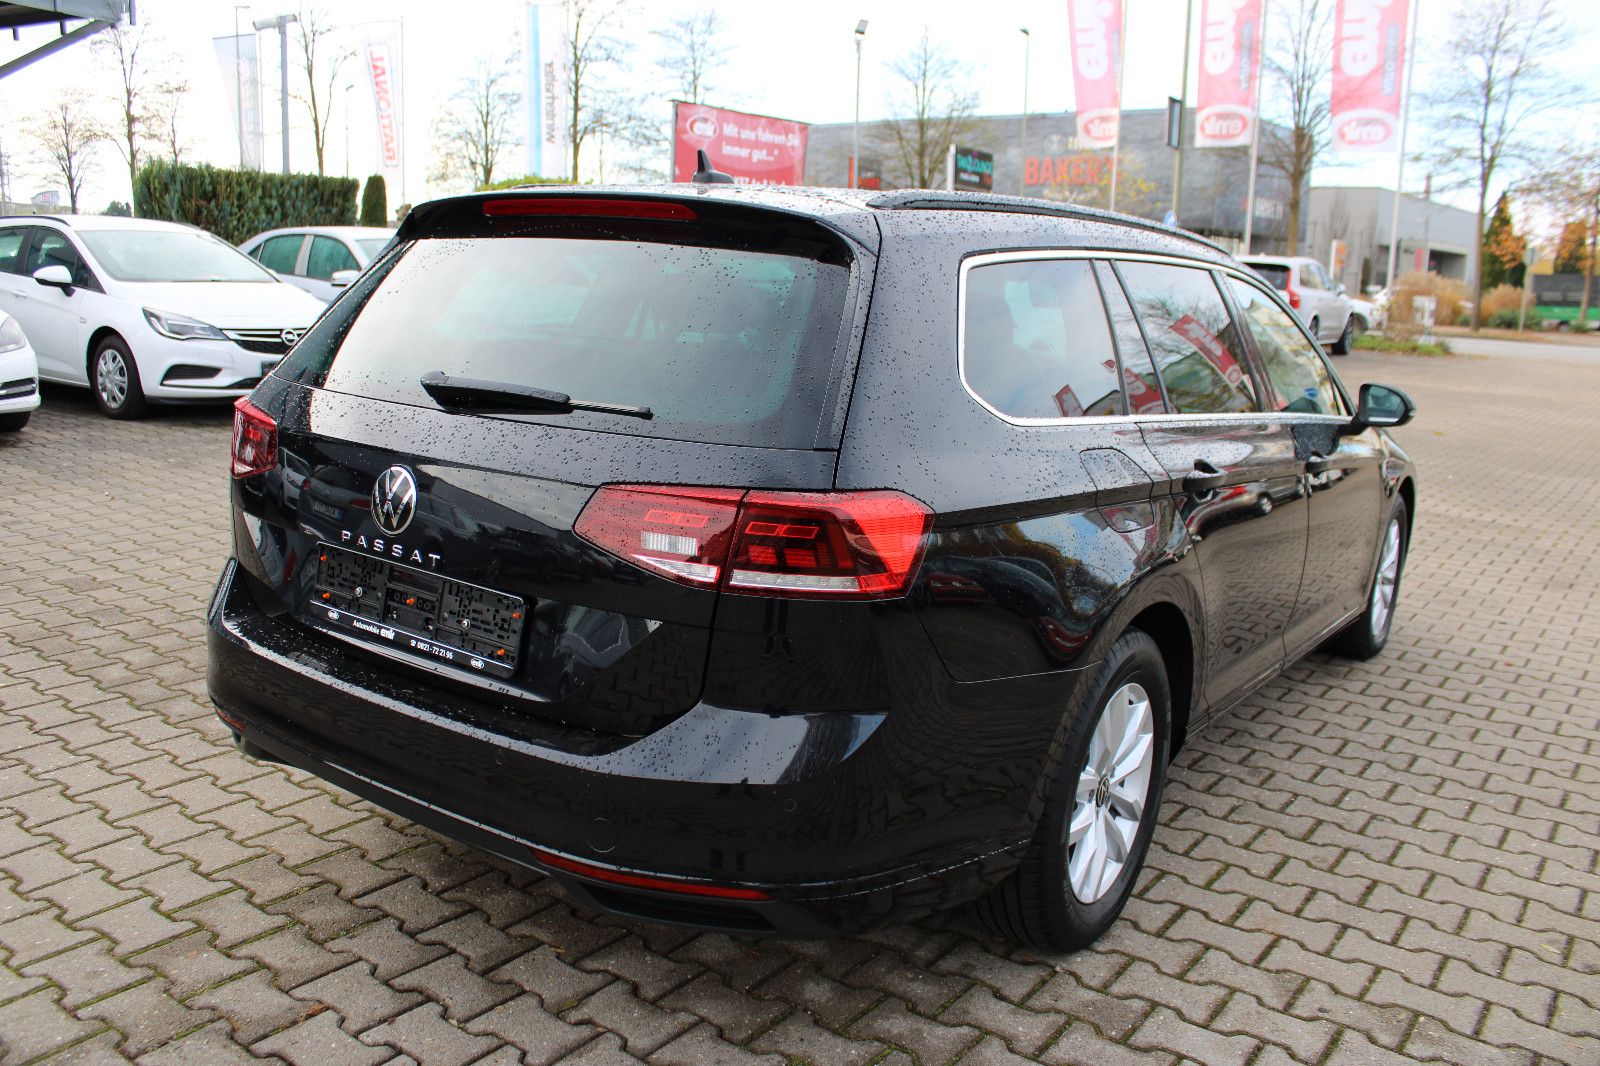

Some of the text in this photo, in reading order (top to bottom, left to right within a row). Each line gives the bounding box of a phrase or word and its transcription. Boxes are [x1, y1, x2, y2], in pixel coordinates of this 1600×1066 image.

[341, 530, 441, 567] PASSAT
[353, 620, 396, 641] Automobile emir
